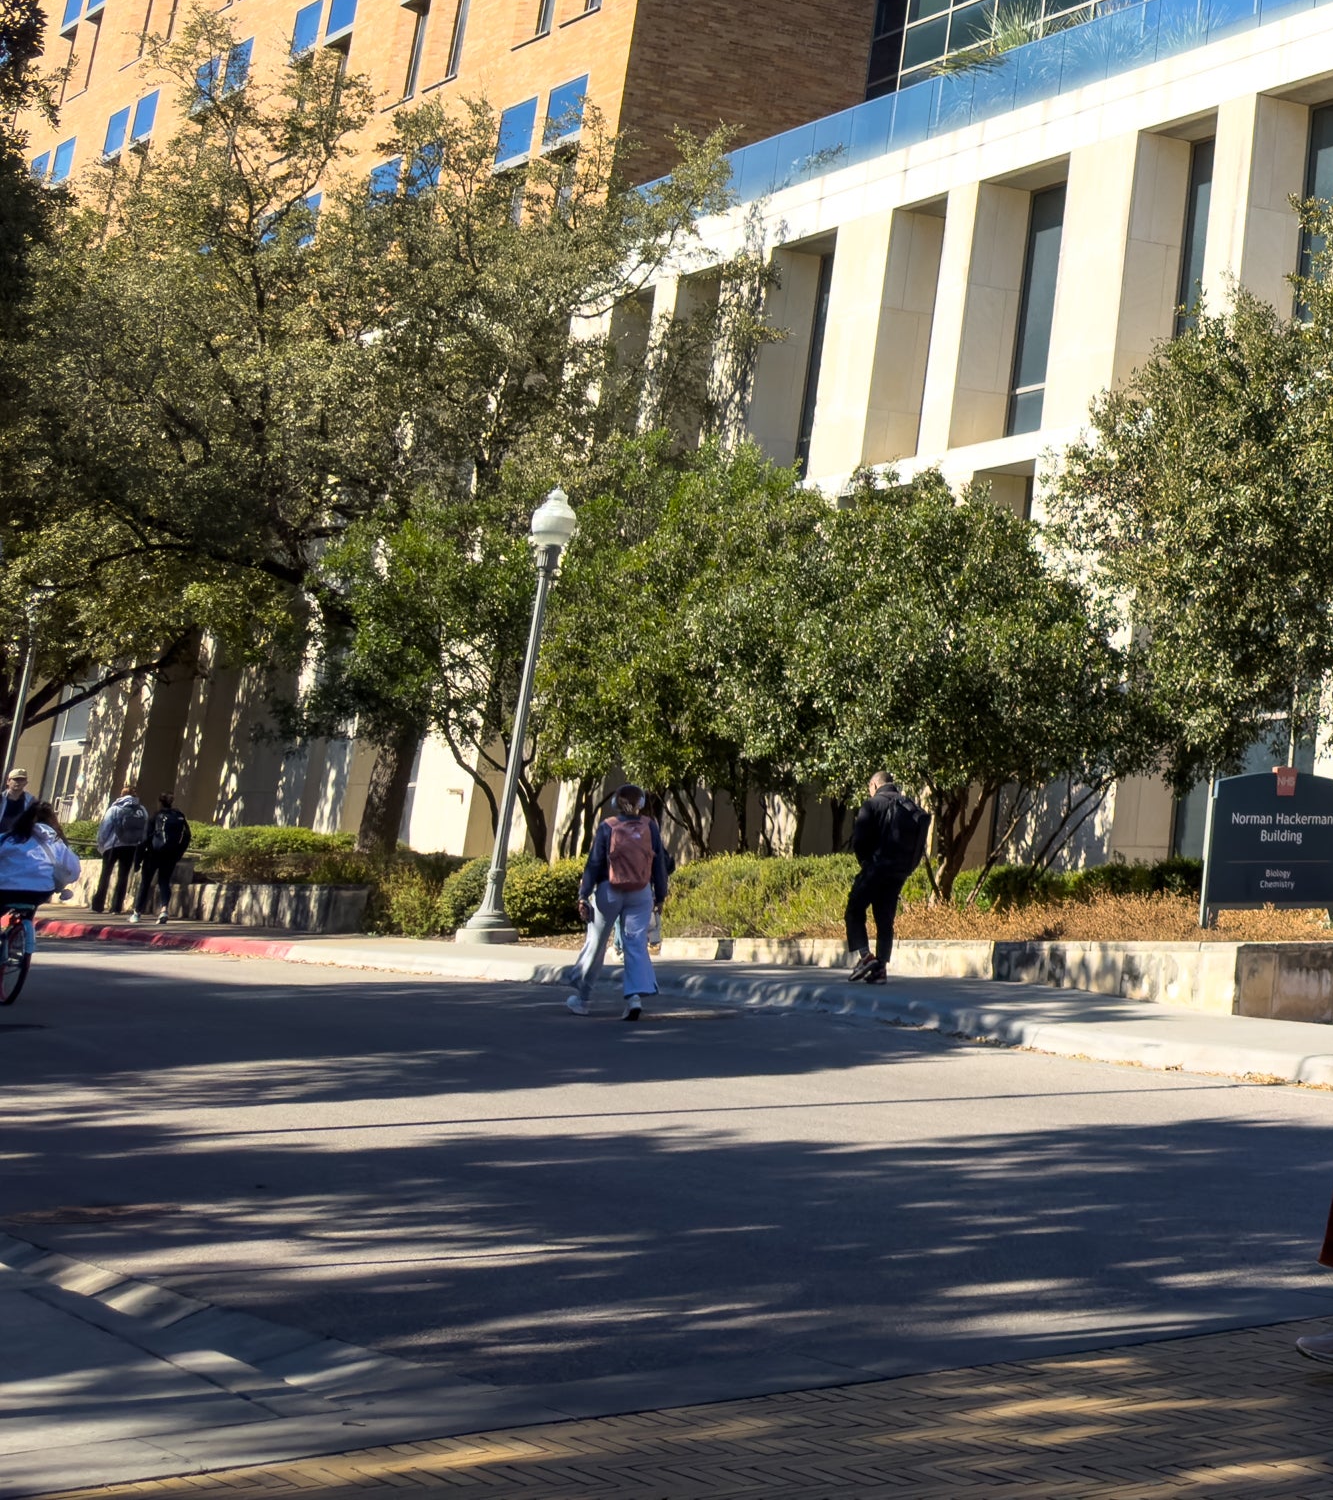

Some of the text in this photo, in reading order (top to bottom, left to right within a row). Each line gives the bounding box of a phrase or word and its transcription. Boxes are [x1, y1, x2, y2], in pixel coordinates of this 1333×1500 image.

[1231, 812, 1333, 825] Norman Hackerman
[1260, 829, 1303, 845] Building
[1265, 869, 1291, 879] Biology
[1260, 880, 1295, 890] Chemistry
